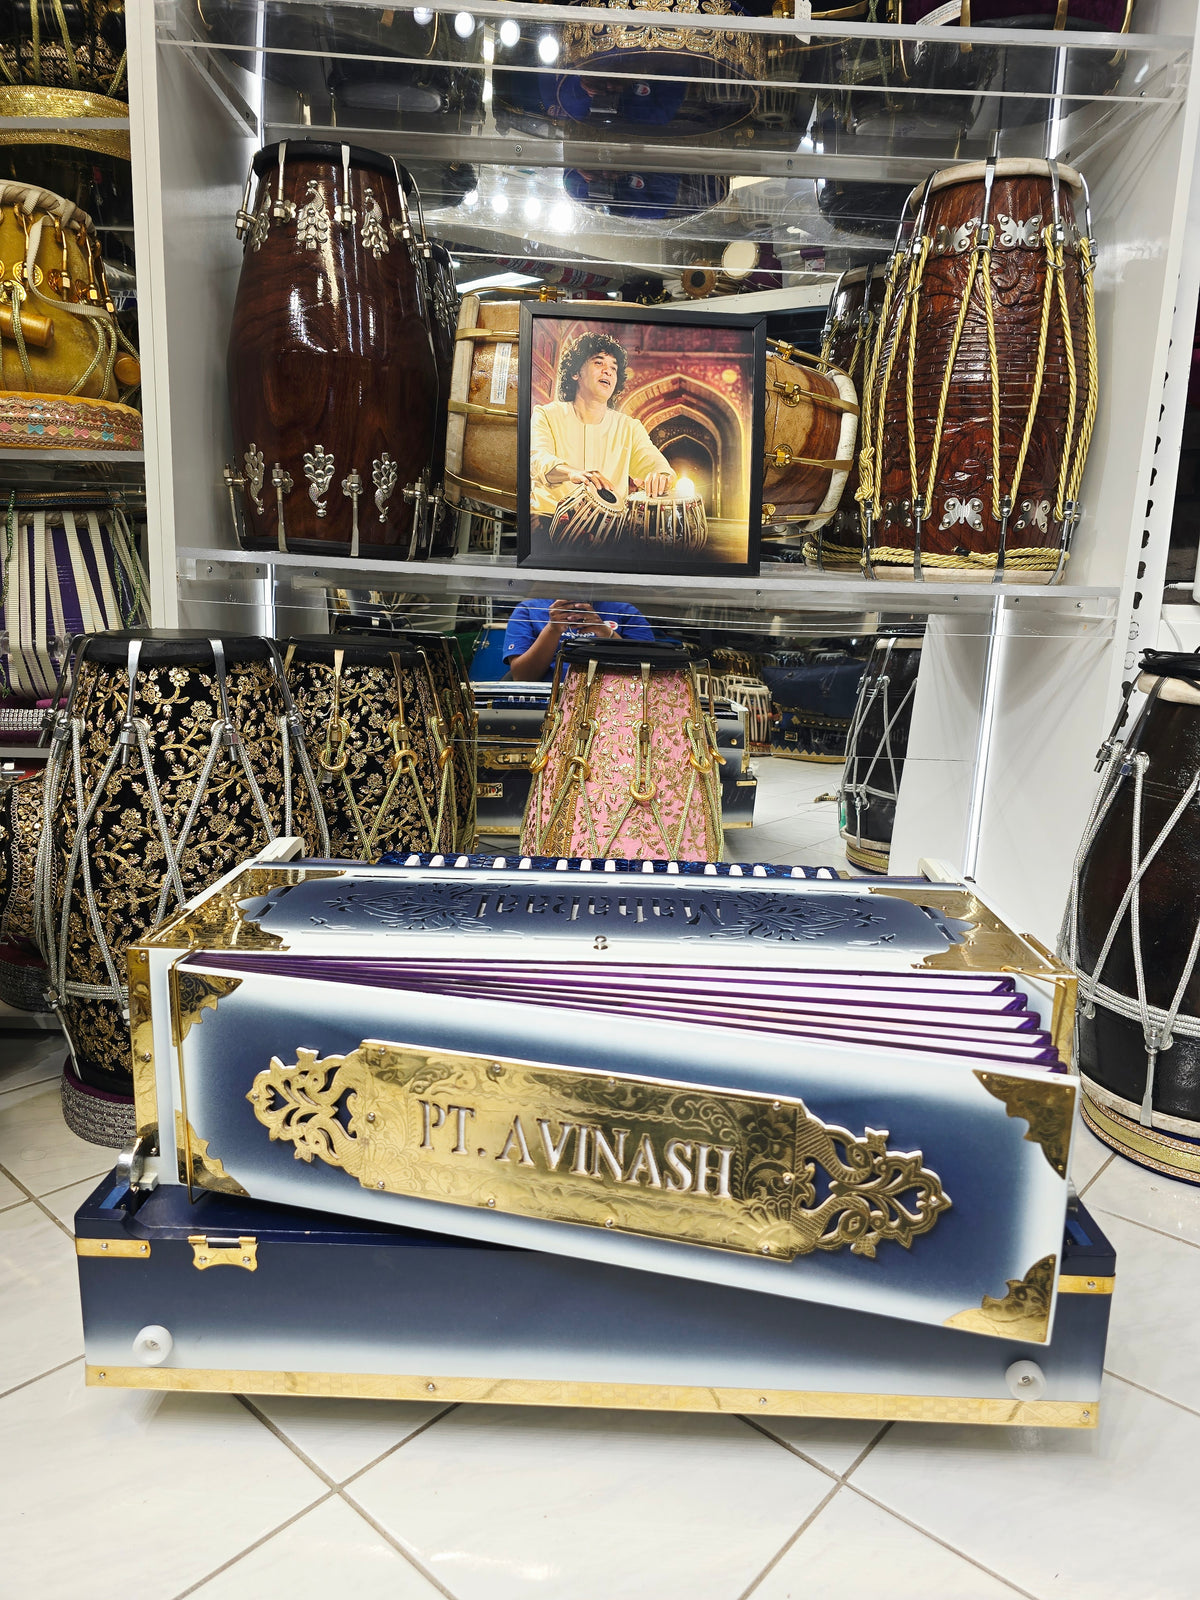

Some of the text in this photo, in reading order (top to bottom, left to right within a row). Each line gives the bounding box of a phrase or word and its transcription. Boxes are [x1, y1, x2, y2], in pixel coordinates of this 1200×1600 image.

[476, 894, 725, 926] Mahakaal
[418, 1099, 735, 1199] PT. AVINASH
